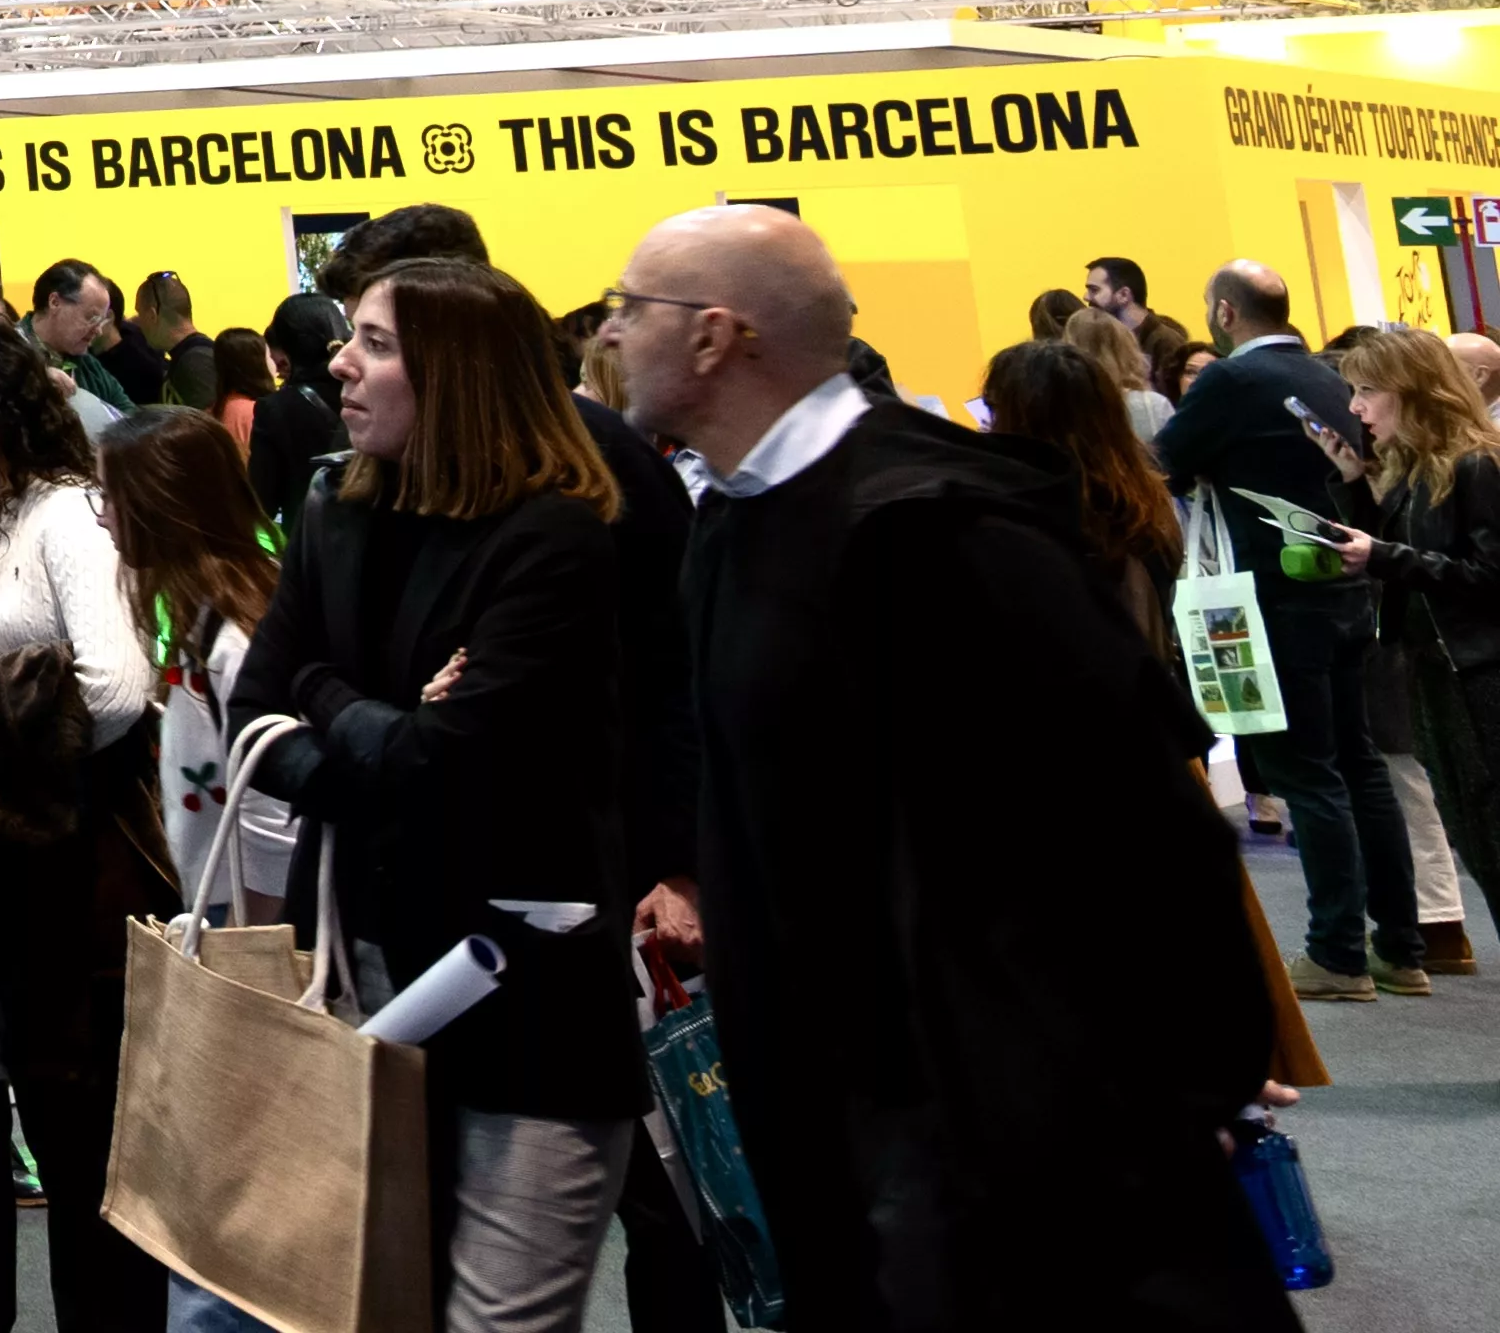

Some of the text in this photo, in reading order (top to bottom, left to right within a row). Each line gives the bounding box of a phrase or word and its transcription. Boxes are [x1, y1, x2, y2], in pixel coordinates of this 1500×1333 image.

[25, 140, 72, 192] IS
[91, 125, 406, 189] BARCELONA
[498, 113, 635, 173] THIS
[658, 109, 718, 167] IS
[740, 88, 1140, 164] BARCELONA
[1224, 86, 1296, 151] GRAND
[1293, 84, 1368, 157] DÉPART
[1367, 102, 1420, 161] TOUR
[1415, 106, 1444, 162] DE
